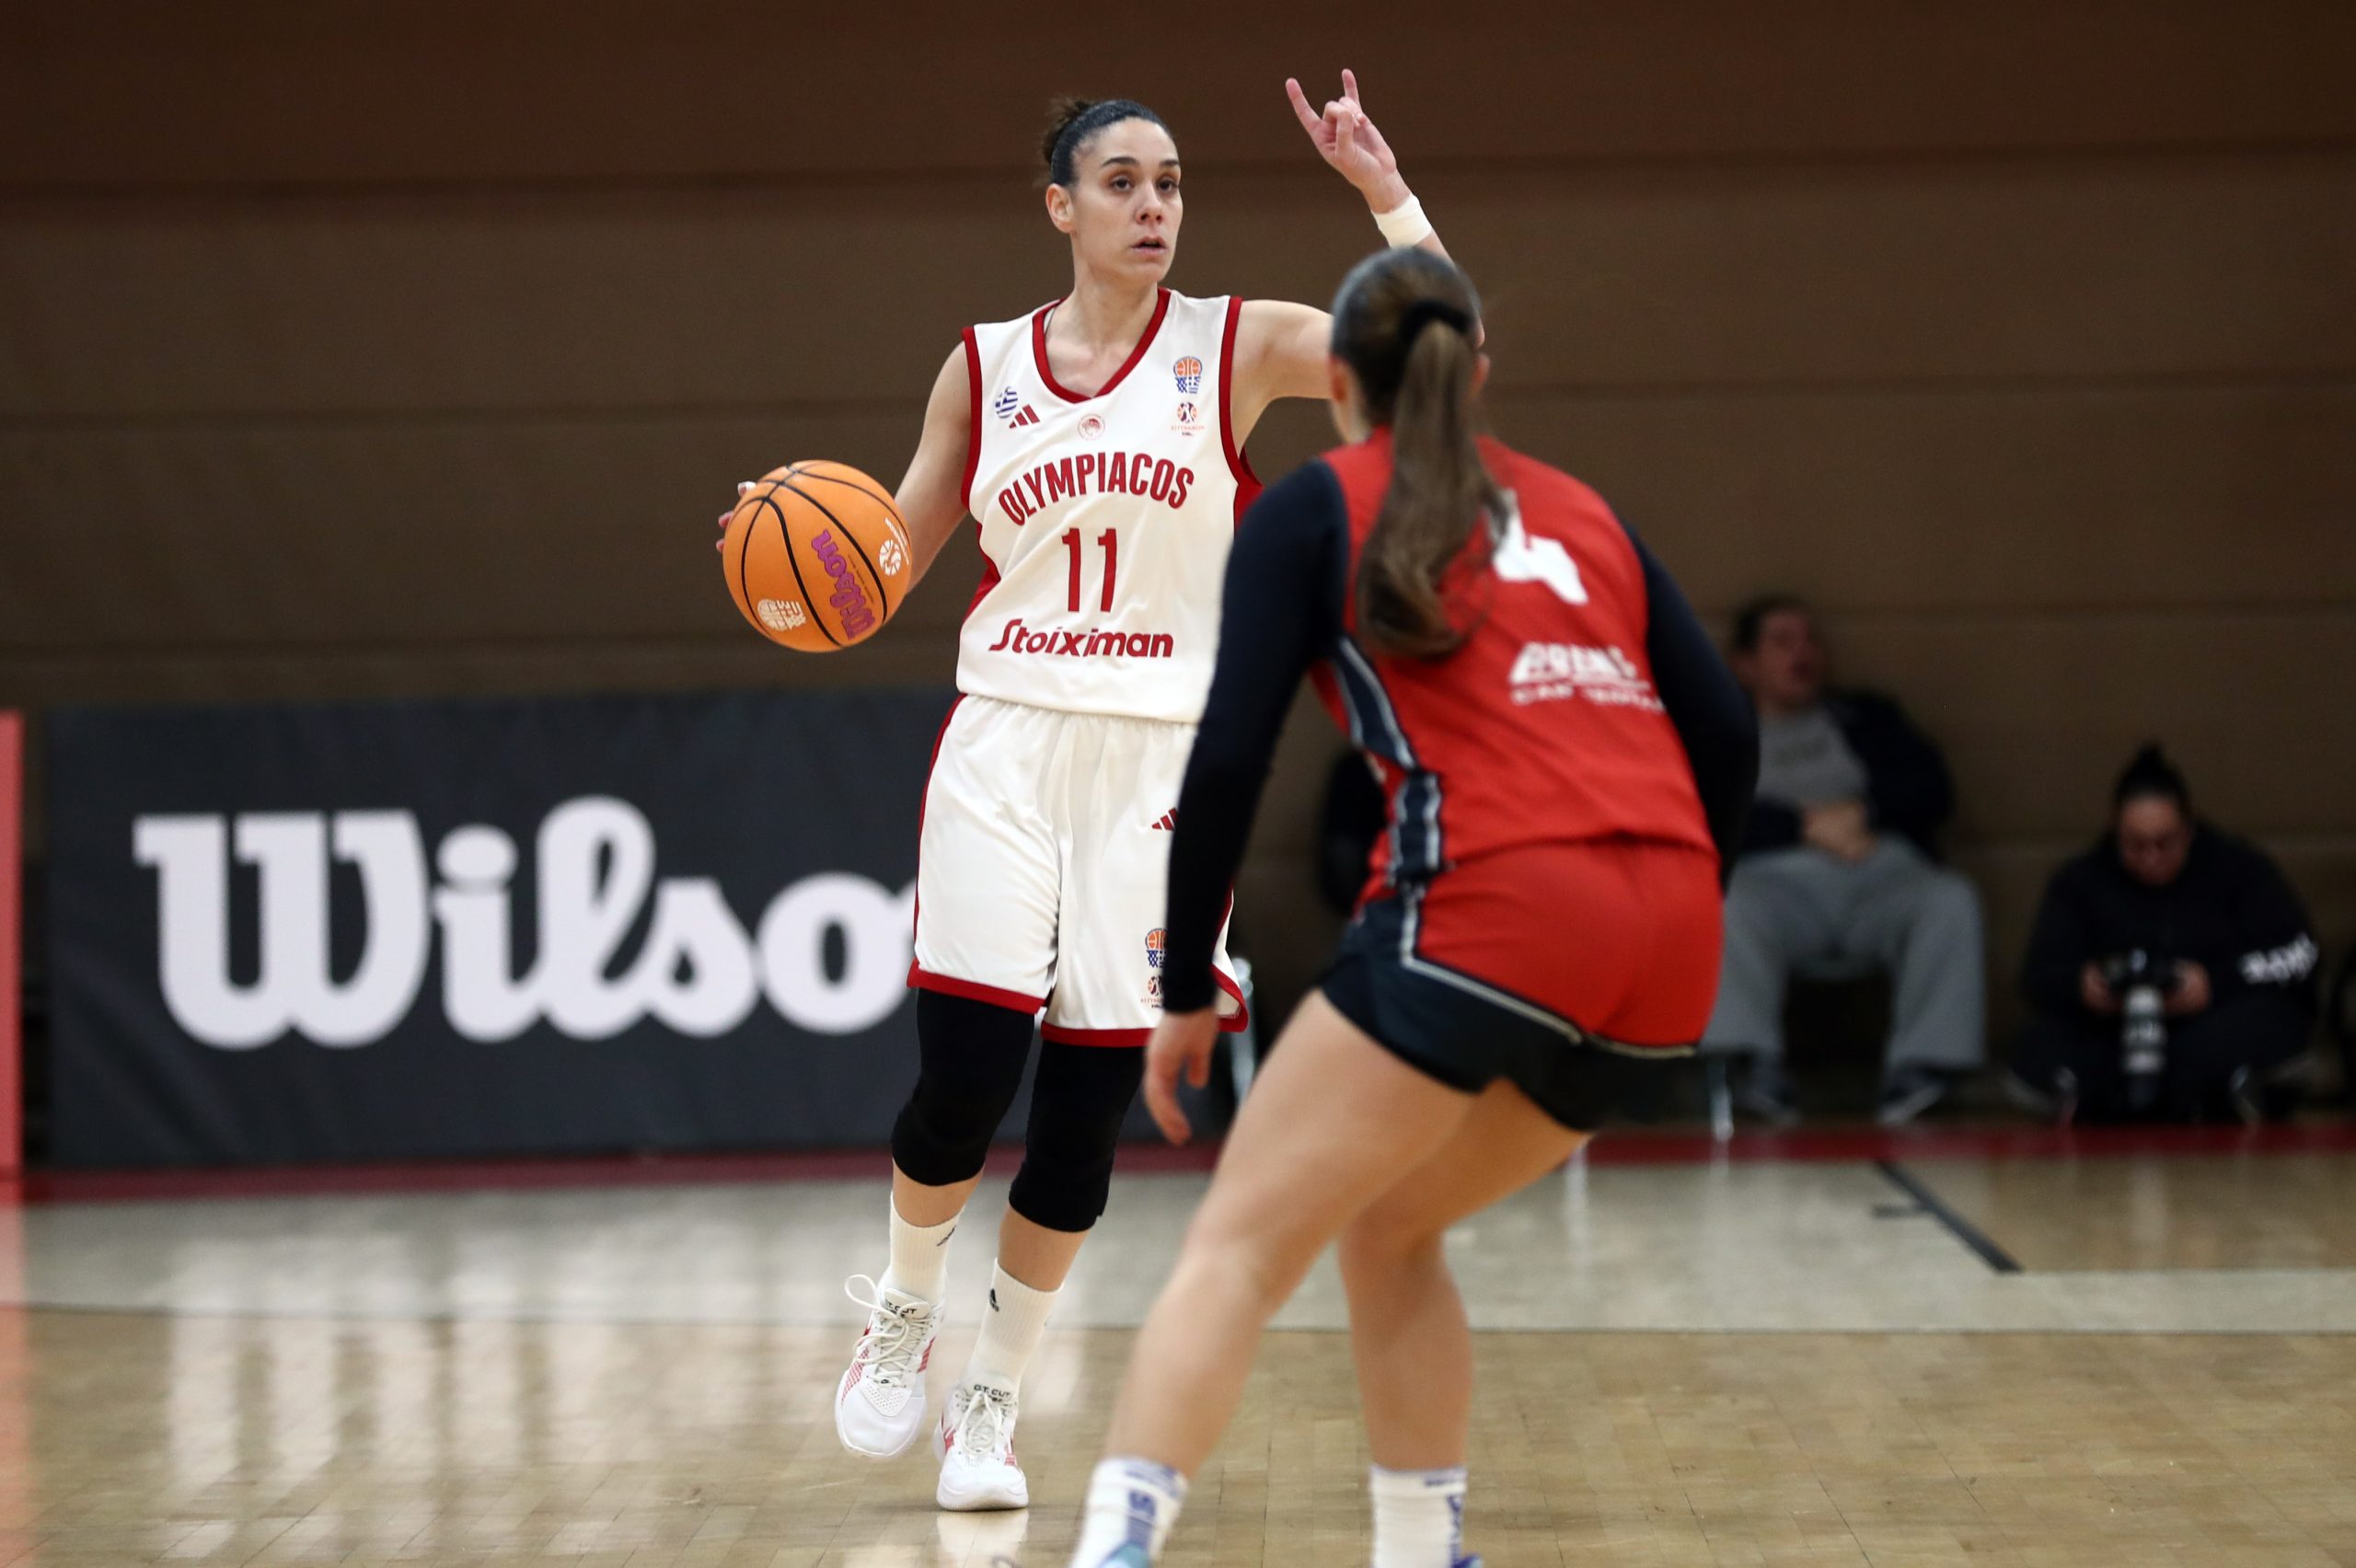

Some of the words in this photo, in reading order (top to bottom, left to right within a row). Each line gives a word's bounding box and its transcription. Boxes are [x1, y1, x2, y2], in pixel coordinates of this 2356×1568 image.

[999, 452, 1194, 526] OLYMPIACOS
[812, 528, 875, 640] Wilson
[1061, 527, 1117, 613] 11
[1485, 488, 1589, 605] 4
[988, 618, 1173, 657] Stoiximan
[133, 795, 918, 1051] Wilso
